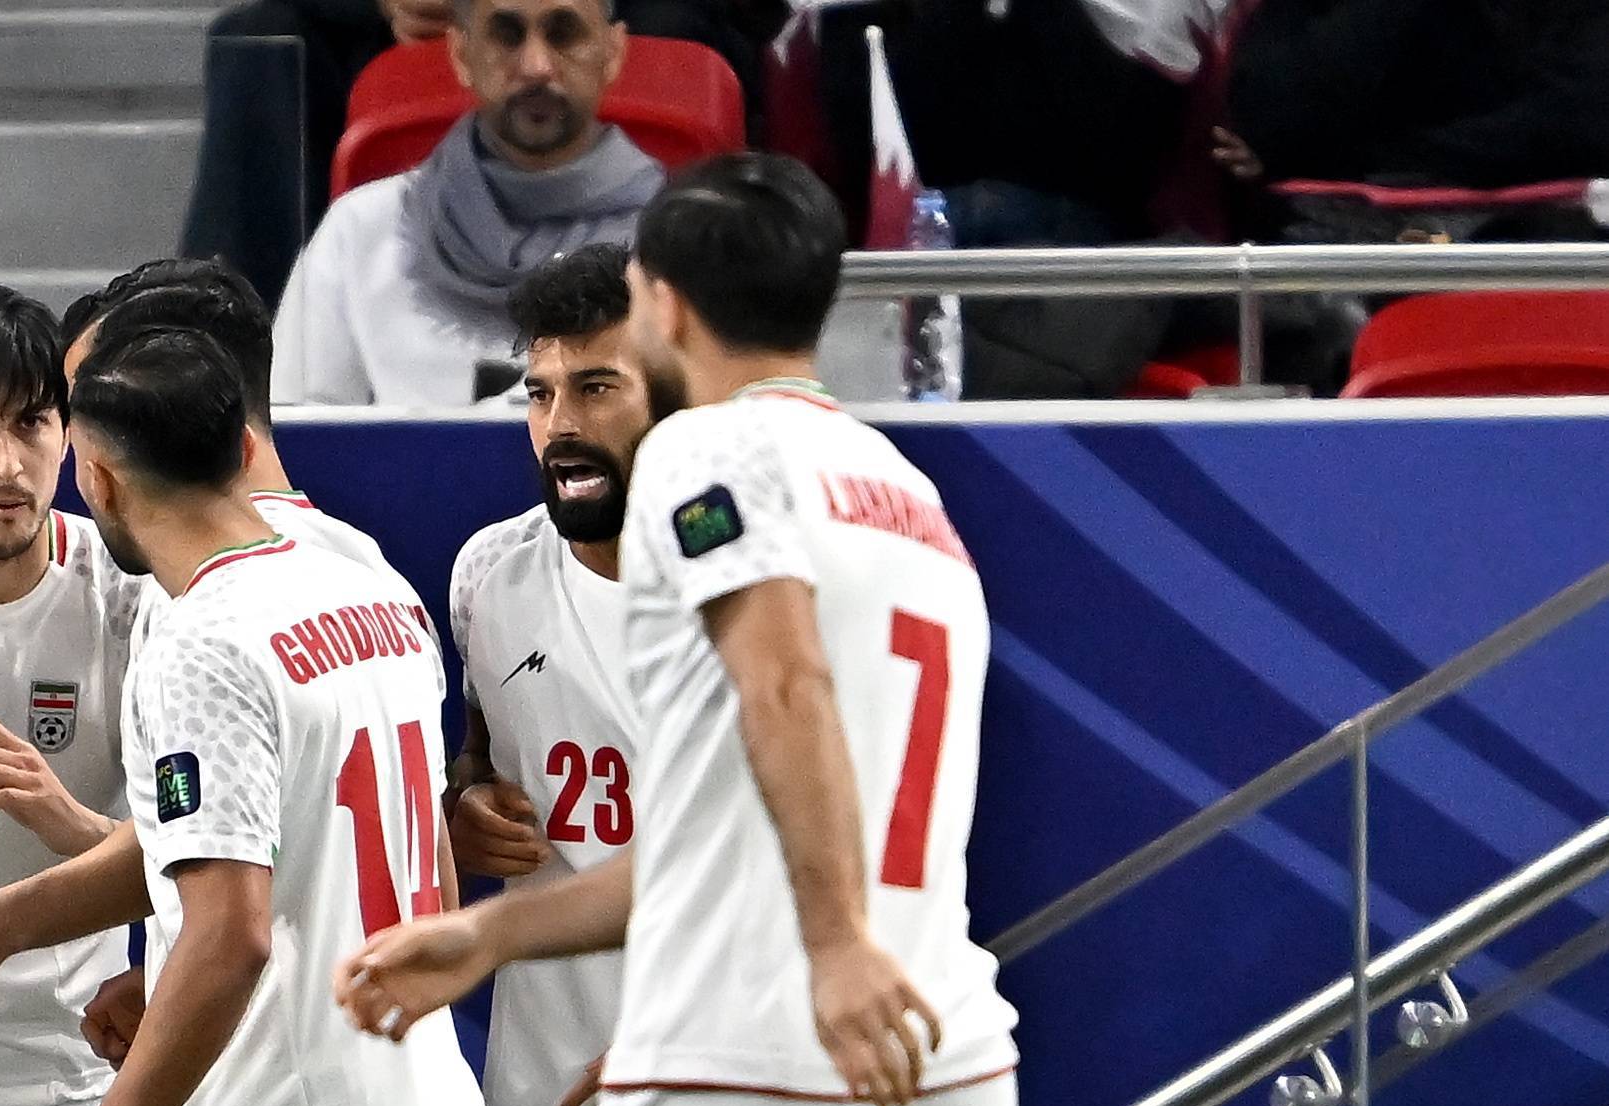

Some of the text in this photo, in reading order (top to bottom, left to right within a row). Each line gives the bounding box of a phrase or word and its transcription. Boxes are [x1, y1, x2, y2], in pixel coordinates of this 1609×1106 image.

[269, 600, 422, 685] GHODDOS
[336, 719, 442, 939] 14
[546, 740, 634, 846] 23
[881, 608, 949, 888] 7
